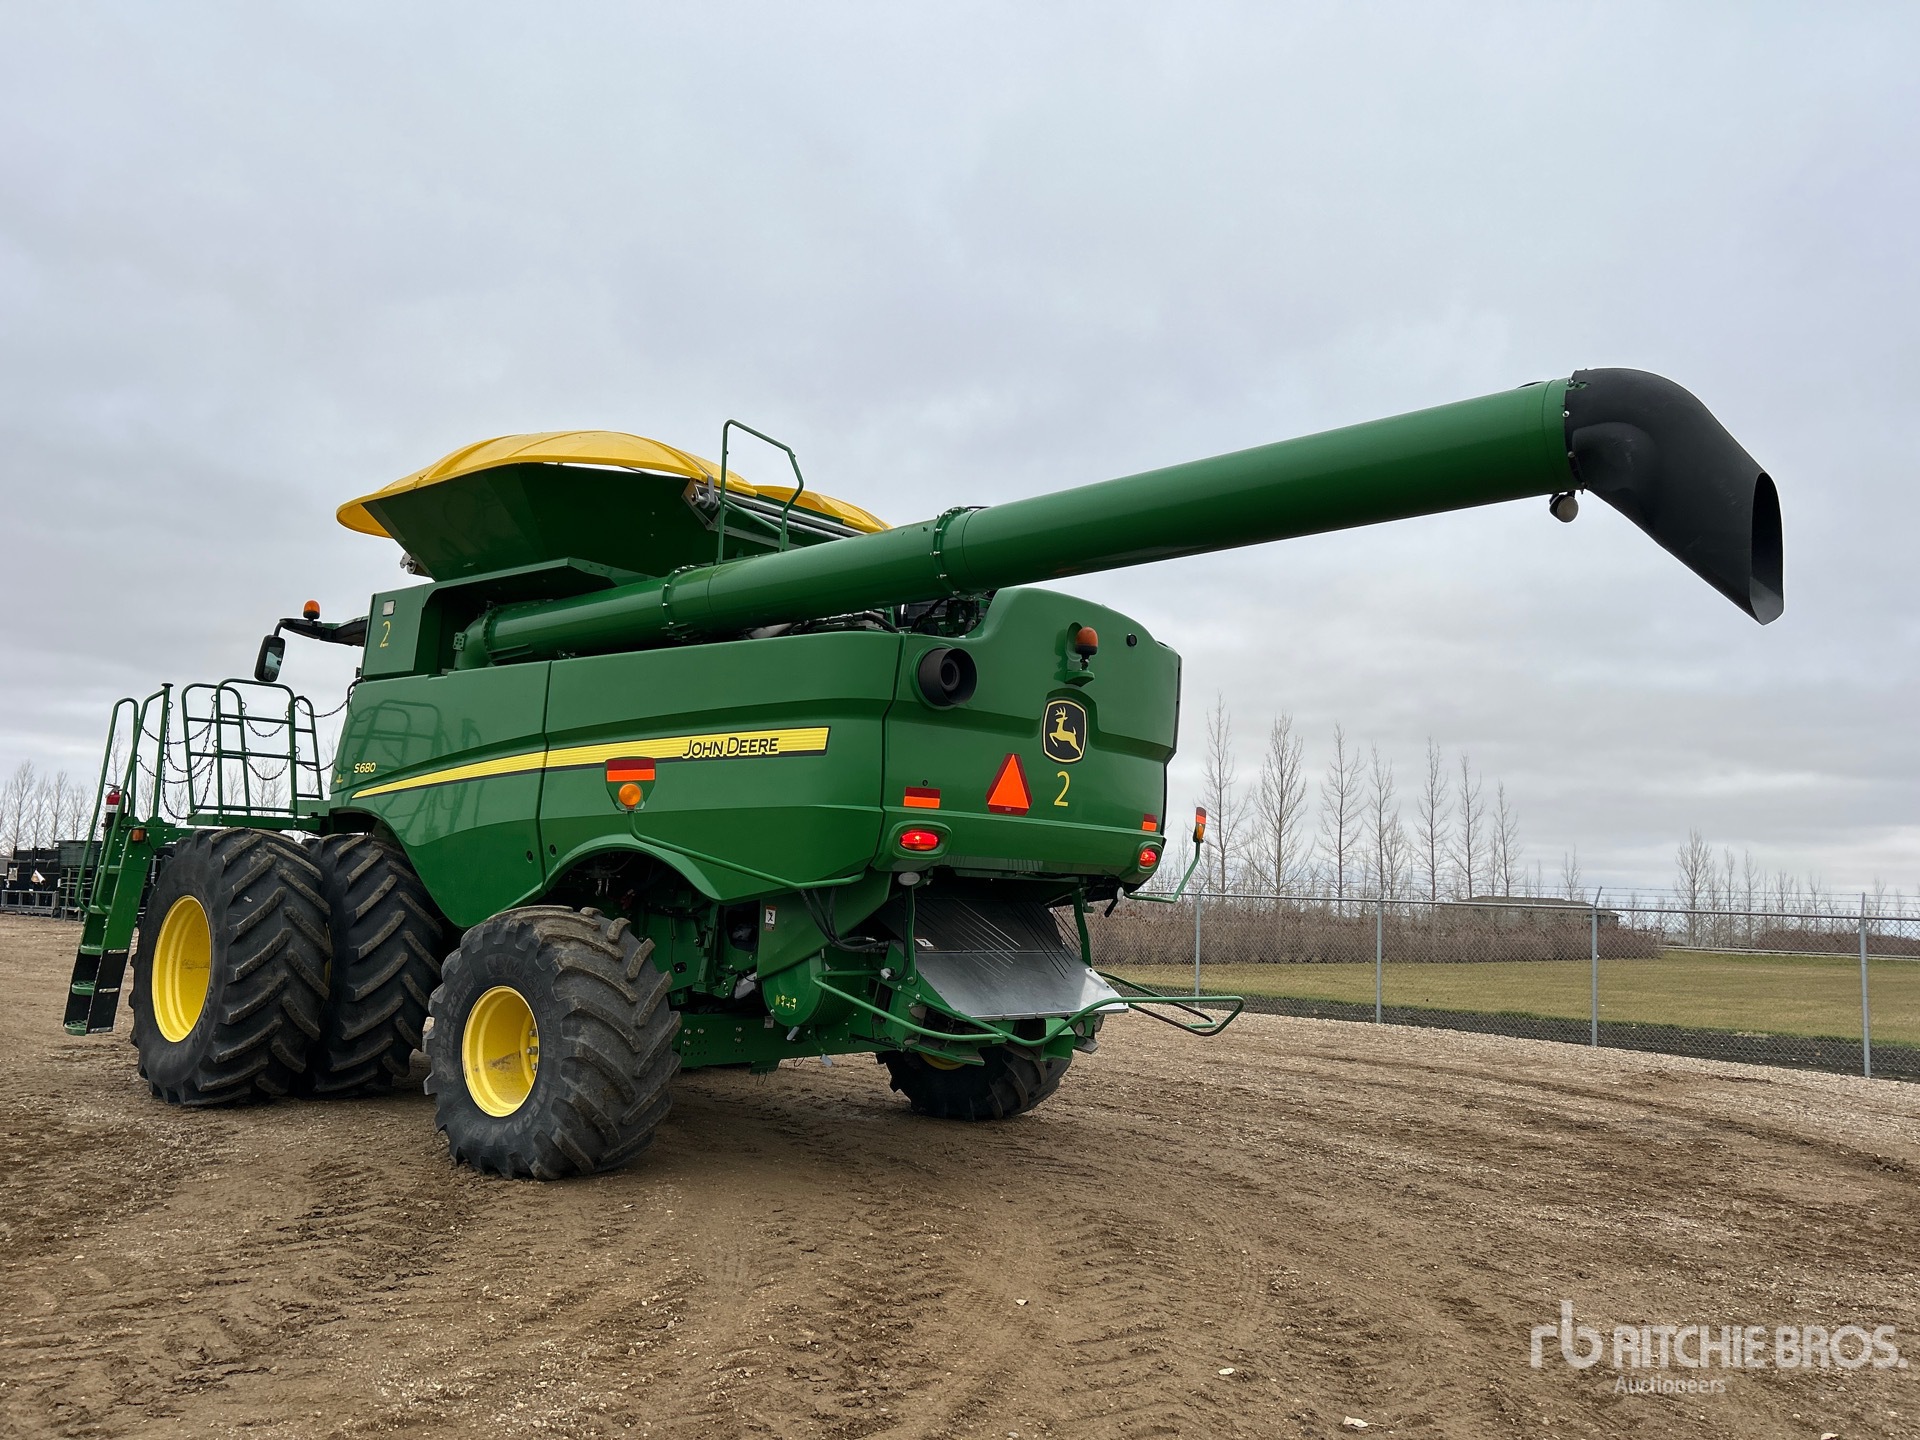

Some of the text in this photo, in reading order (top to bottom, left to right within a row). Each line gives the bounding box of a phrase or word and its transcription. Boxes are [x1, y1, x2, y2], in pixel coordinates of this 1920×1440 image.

[380, 620, 391, 648] 2
[682, 736, 780, 758] JOHN DEERE
[353, 762, 377, 774] S680
[1054, 770, 1070, 807] 2
